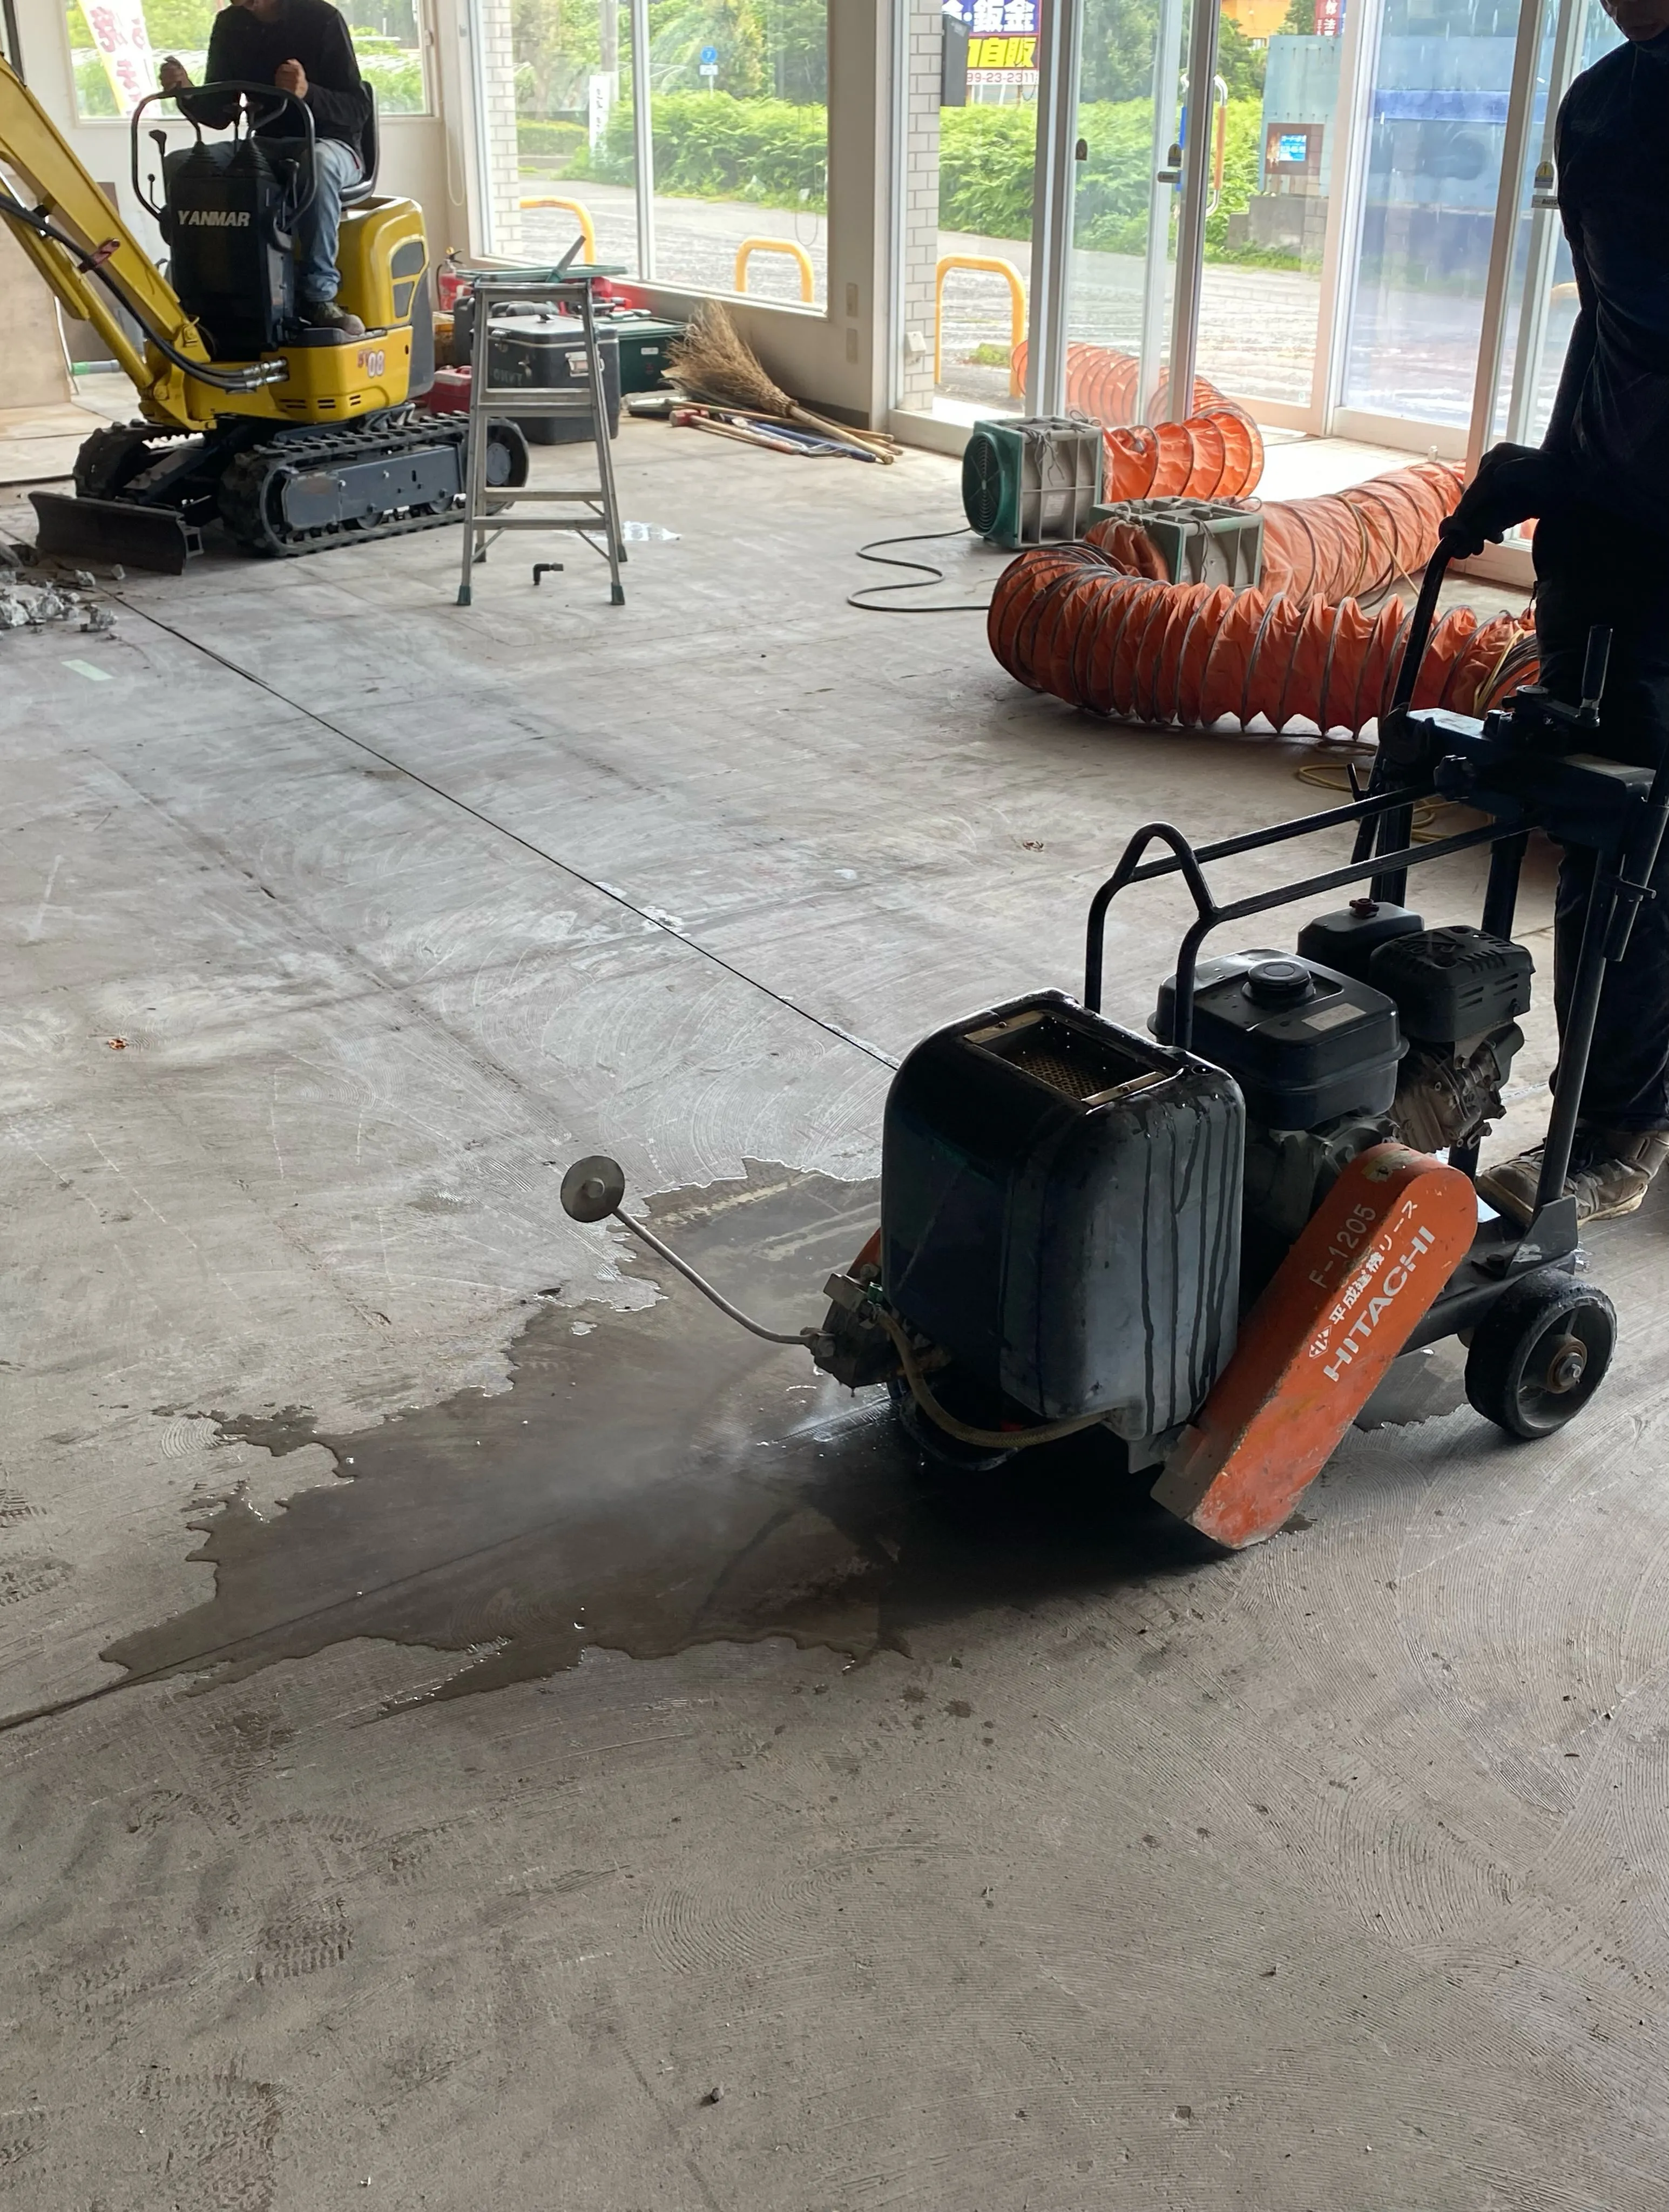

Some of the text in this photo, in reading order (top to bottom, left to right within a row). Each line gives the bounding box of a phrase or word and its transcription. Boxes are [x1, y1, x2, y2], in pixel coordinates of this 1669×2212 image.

[177, 210, 251, 227] YANMAR
[1308, 1203, 1376, 1289] F-1205
[1323, 1225, 1436, 1382] HITACHI
